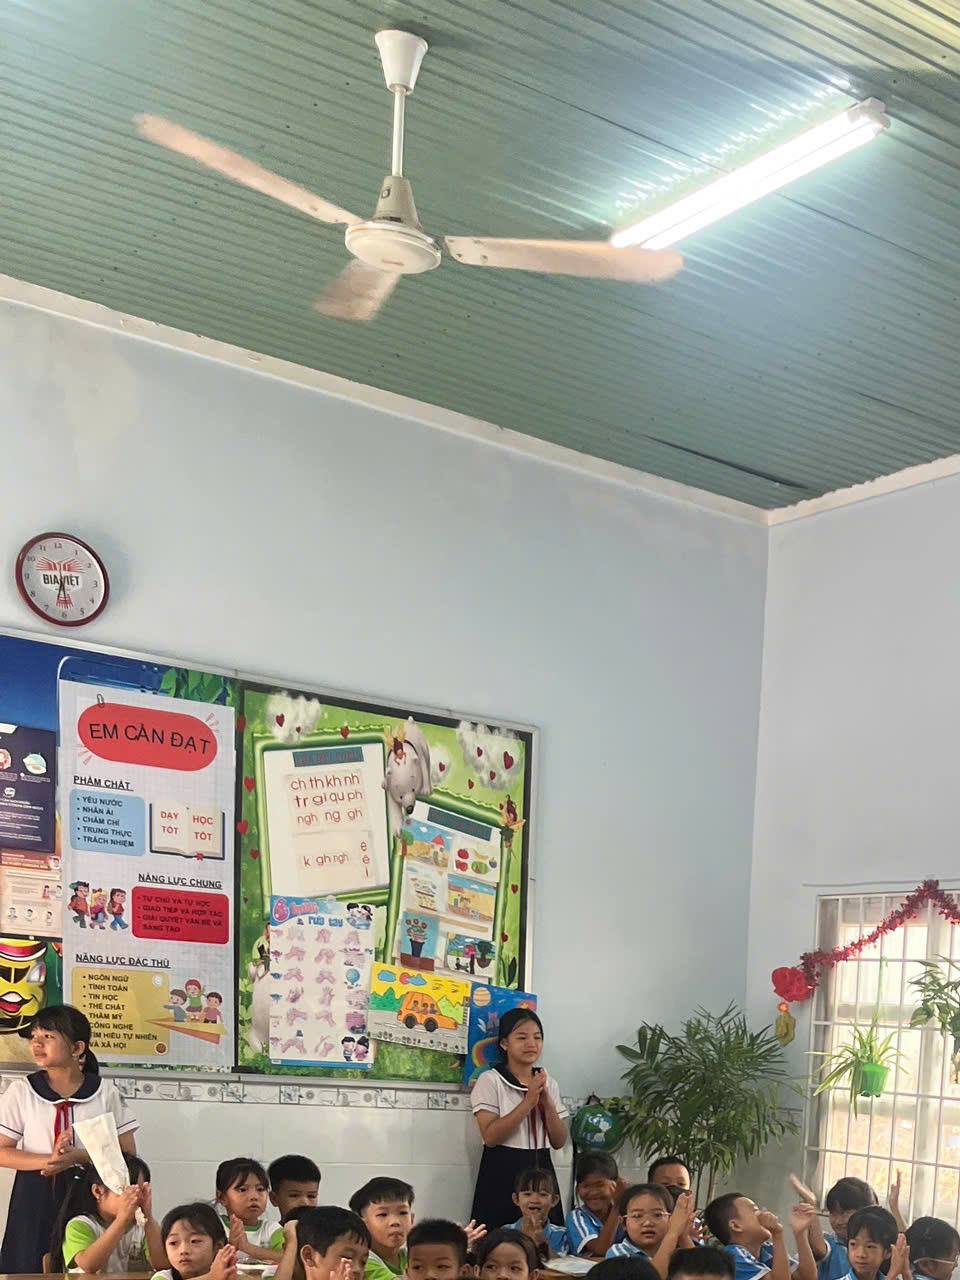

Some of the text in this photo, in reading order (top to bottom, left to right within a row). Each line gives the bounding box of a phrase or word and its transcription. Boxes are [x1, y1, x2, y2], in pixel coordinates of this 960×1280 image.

[42, 573, 59, 585] BIA
[89, 723, 119, 740] EM
[170, 732, 211, 754] ĐẠT
[290, 773, 360, 791] ch th kh nh
[82, 796, 123, 807] YÊU NƯỚC
[295, 795, 309, 808] tr
[329, 792, 345, 804] qu
[347, 790, 363, 802] ph
[192, 815, 214, 826] HỌC
[297, 808, 363, 826] ngh ng gh
[83, 826, 133, 838] TRUNG THỰC
[83, 835, 109, 844] TRÁCH
[303, 852, 349, 867] k gh ngh
[189, 878, 223, 890] CHUNG
[75, 953, 103, 964] NĂNG
[88, 973, 129, 982] NGÔN NGỮ
[107, 984, 128, 992] TOÁN
[88, 992, 118, 1002] TIN HỌC
